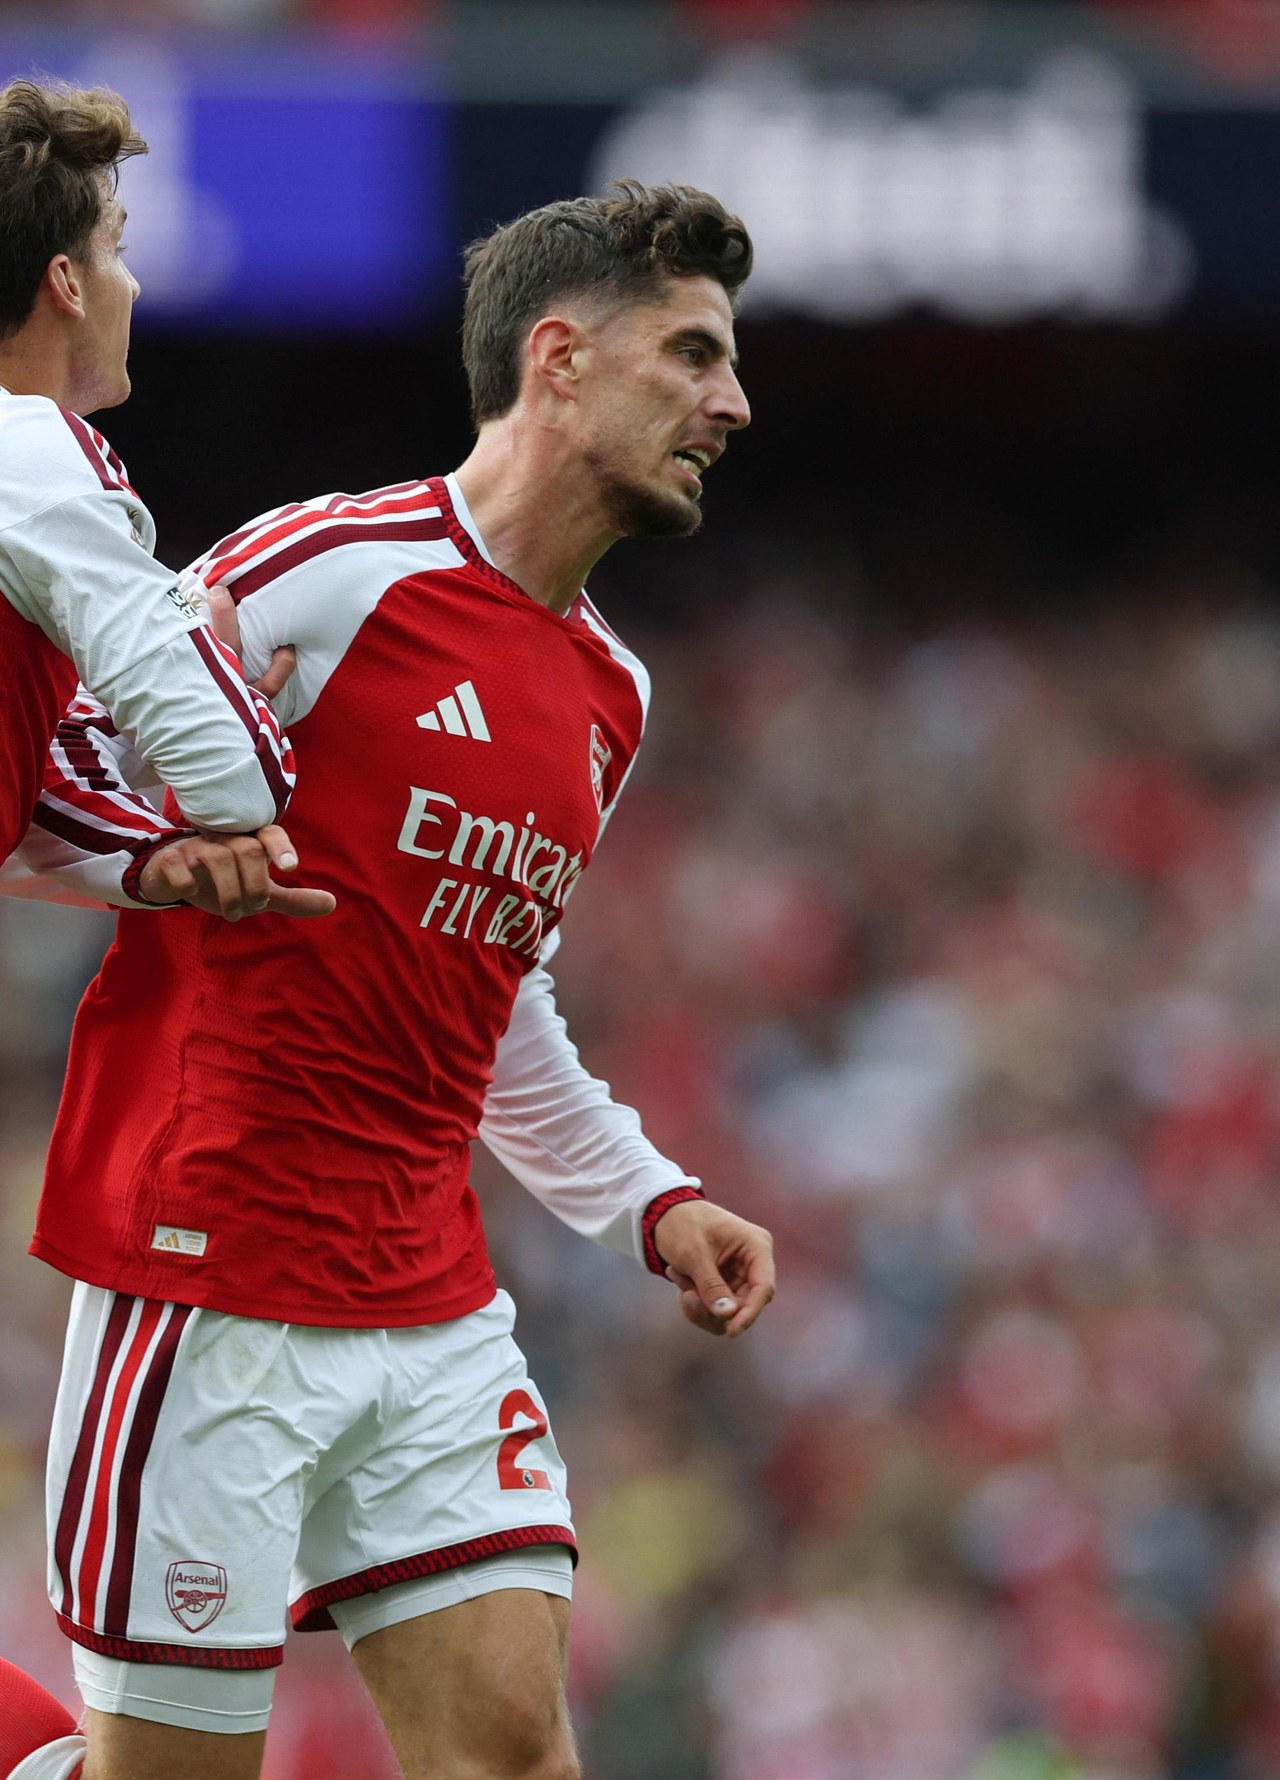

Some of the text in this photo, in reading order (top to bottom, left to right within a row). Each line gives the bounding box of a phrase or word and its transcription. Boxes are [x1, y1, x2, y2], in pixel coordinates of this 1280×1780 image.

[420, 877, 491, 939] FLY
[496, 1388, 554, 1491] 2
[174, 1572, 220, 1587] Arsenal
